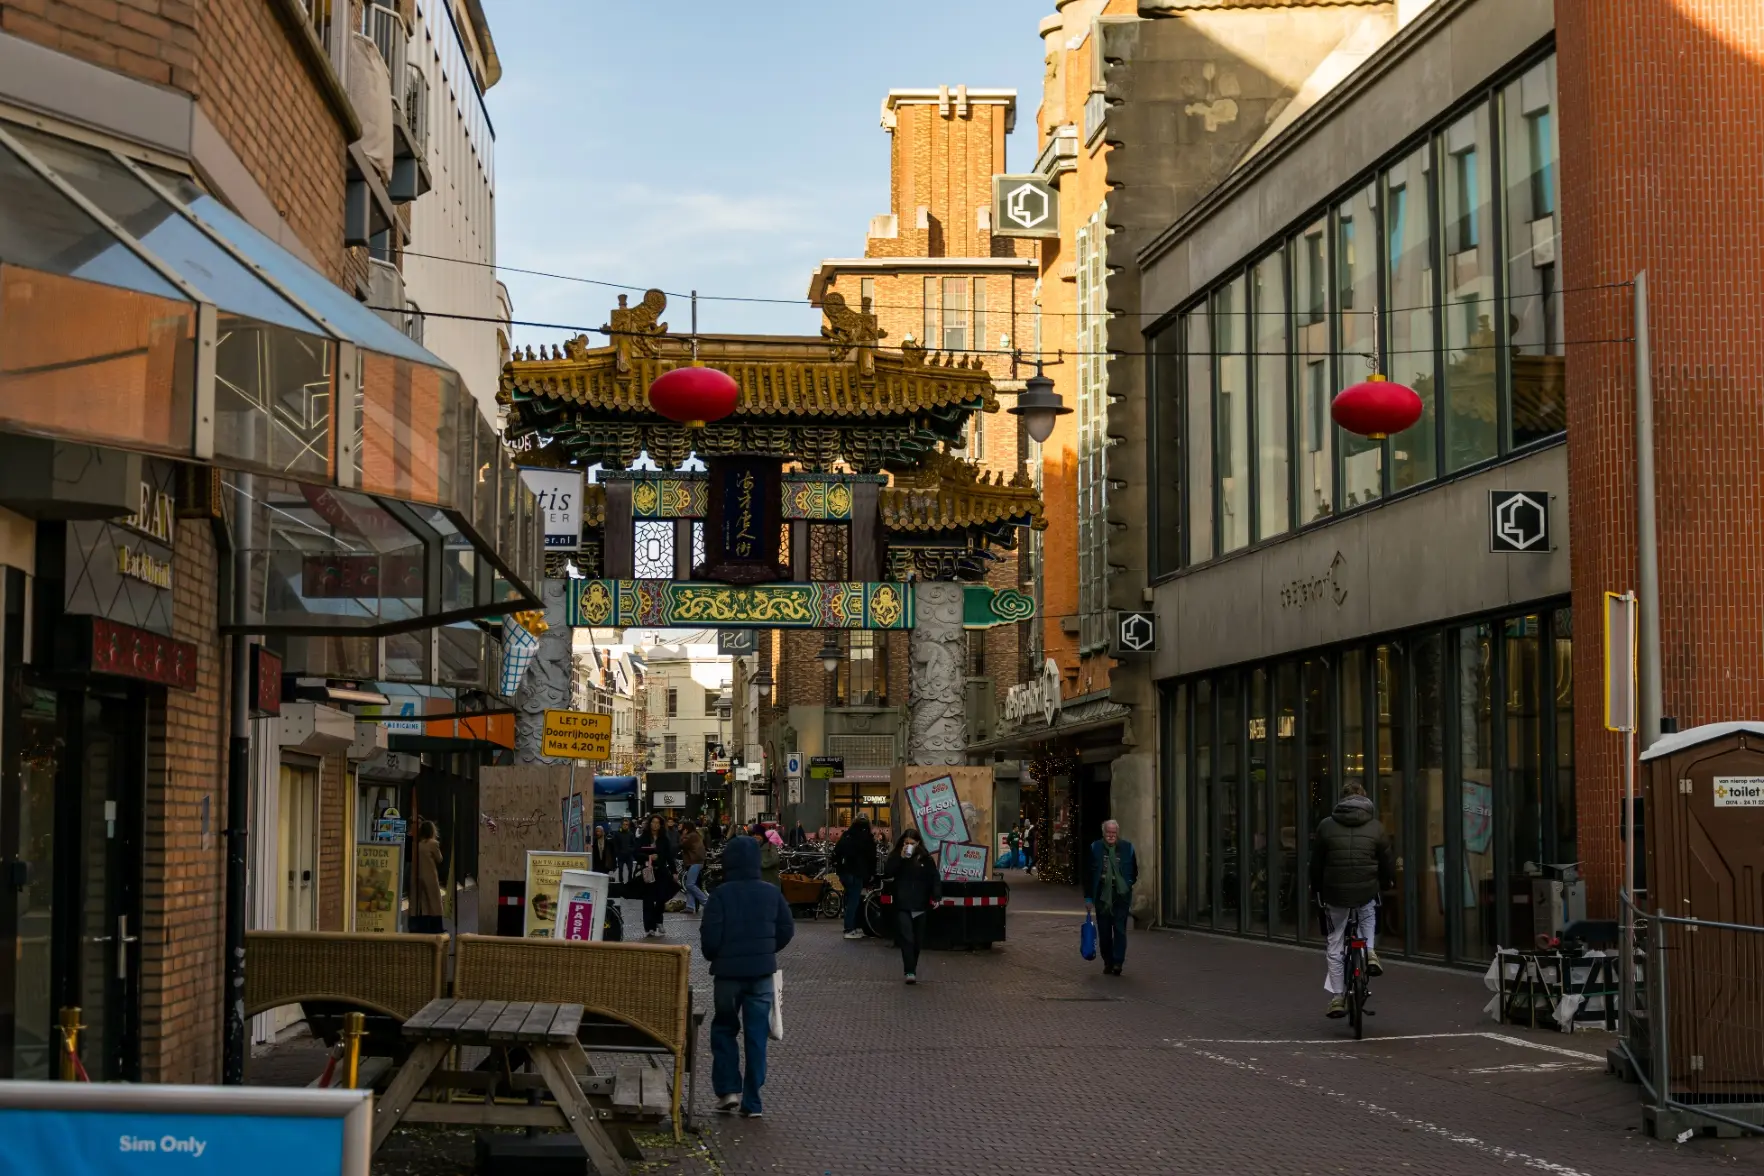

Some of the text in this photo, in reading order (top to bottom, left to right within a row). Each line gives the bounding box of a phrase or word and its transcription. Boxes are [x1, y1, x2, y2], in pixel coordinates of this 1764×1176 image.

[559, 716, 598, 728] LET OP!
[546, 728, 609, 741] Doorrijhoogte
[548, 740, 605, 753] Max 4,20 m
[1729, 786, 1760, 797] toilet
[916, 798, 957, 818] NIELSON
[363, 848, 390, 858] STOCK
[940, 865, 982, 878] NIELSON
[571, 904, 585, 941] PASFO
[119, 1135, 207, 1158] Sim Only
